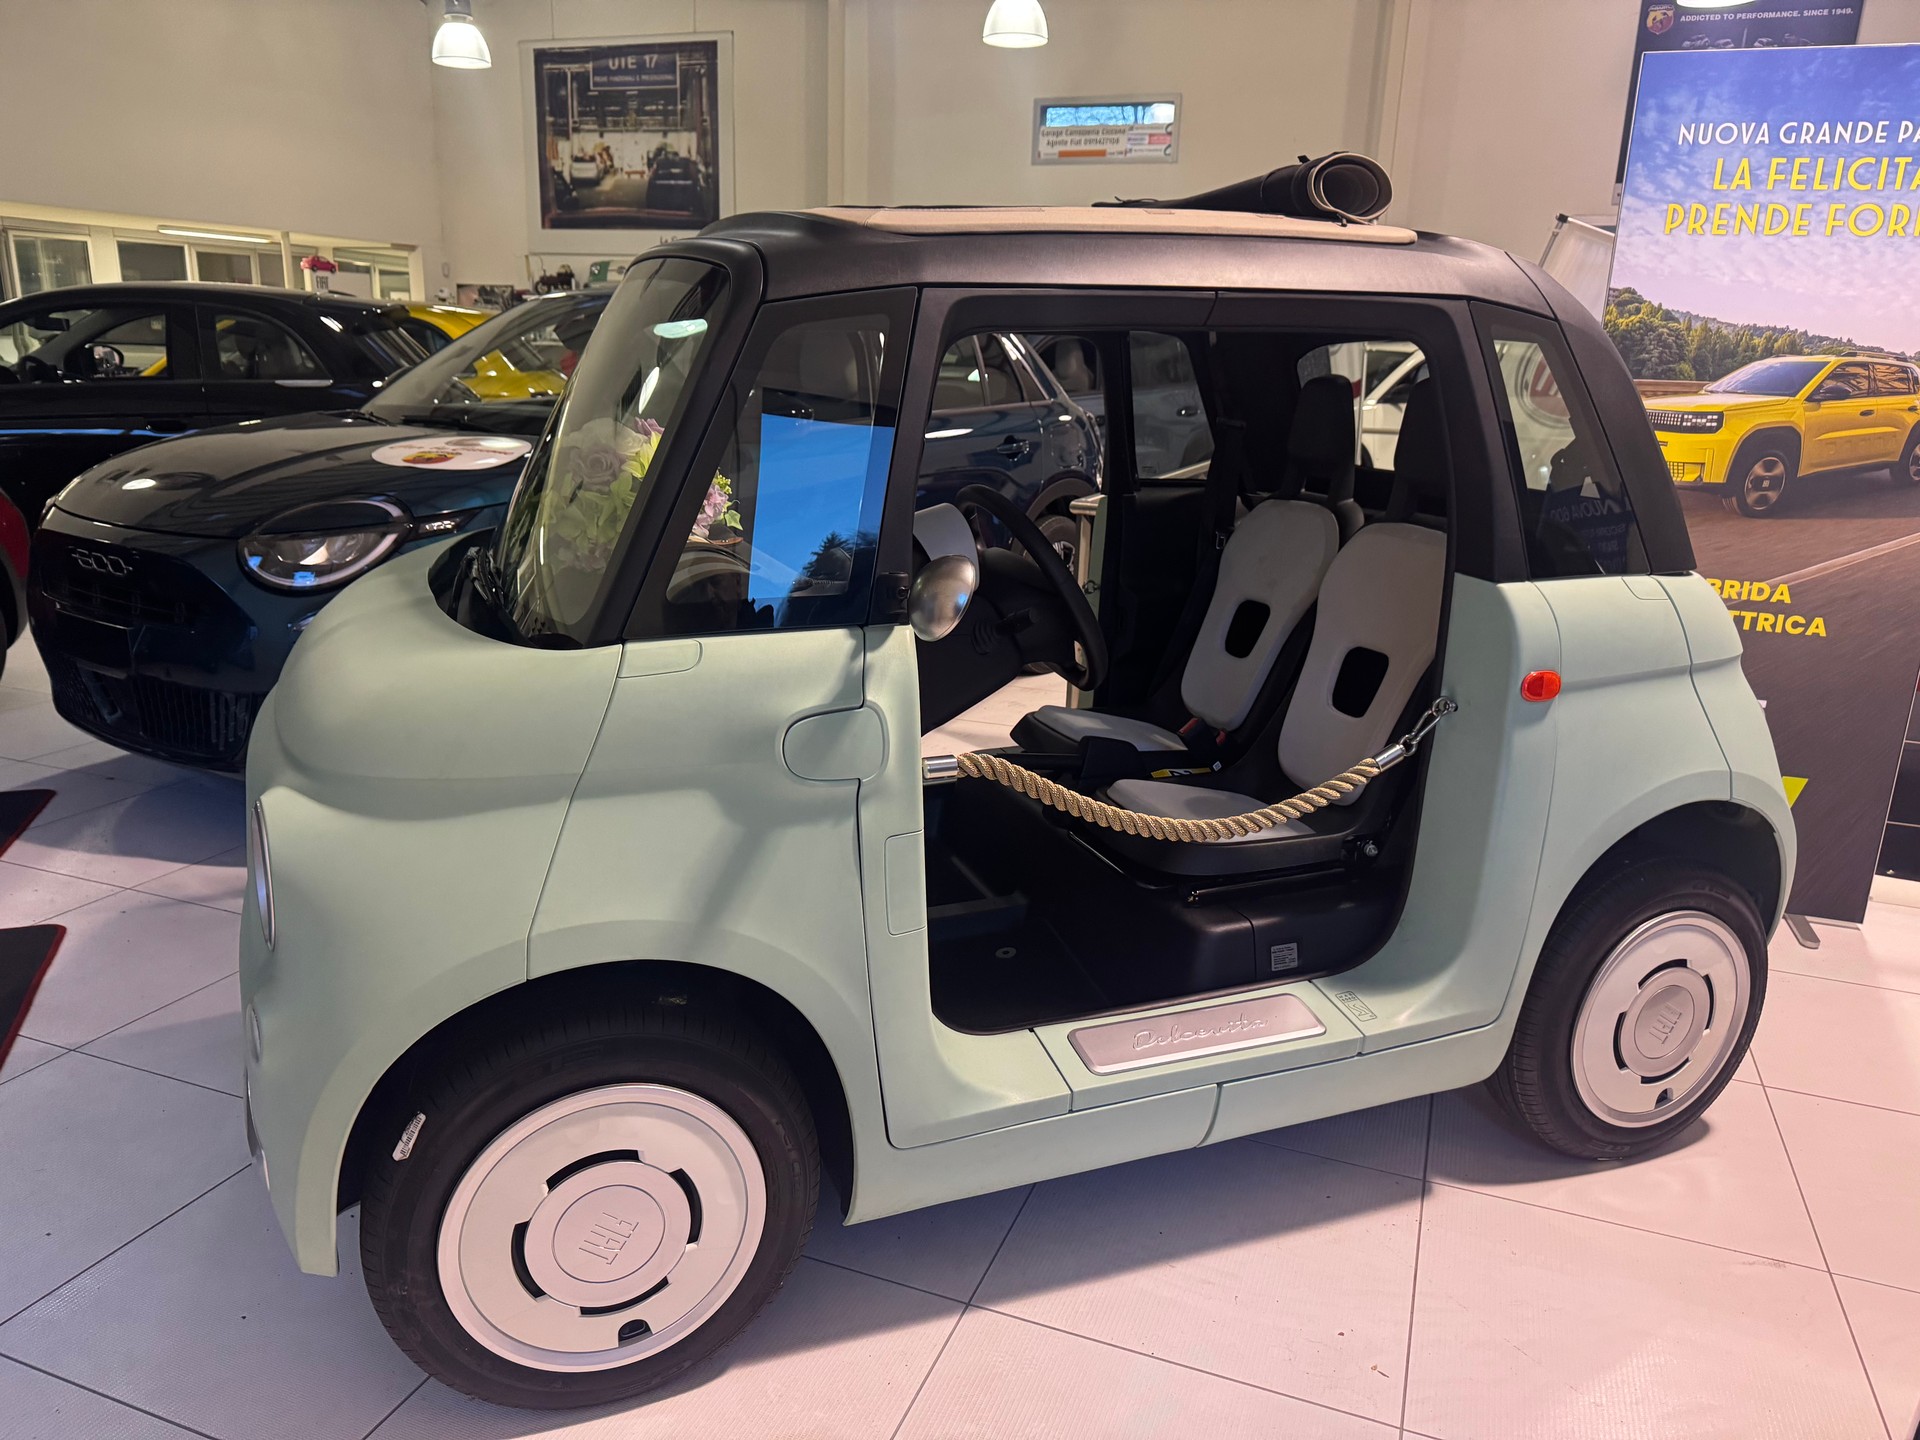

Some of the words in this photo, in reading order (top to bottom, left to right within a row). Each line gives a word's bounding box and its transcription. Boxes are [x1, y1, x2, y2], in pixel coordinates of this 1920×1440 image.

[1680, 14, 1721, 22] ADDICTED
[1736, 11, 1800, 20] PERFORMANCE.
[1803, 9, 1829, 17] SINCE
[643, 53, 659, 69] 17
[1678, 122, 1770, 145] NUOVA
[1779, 121, 1890, 144] GRANDE
[1713, 157, 1752, 190] LA
[1663, 203, 1813, 236] PRENDE
[1825, 203, 1920, 237] FOR
[71, 548, 132, 576] 600
[578, 1211, 640, 1266] FIAT
